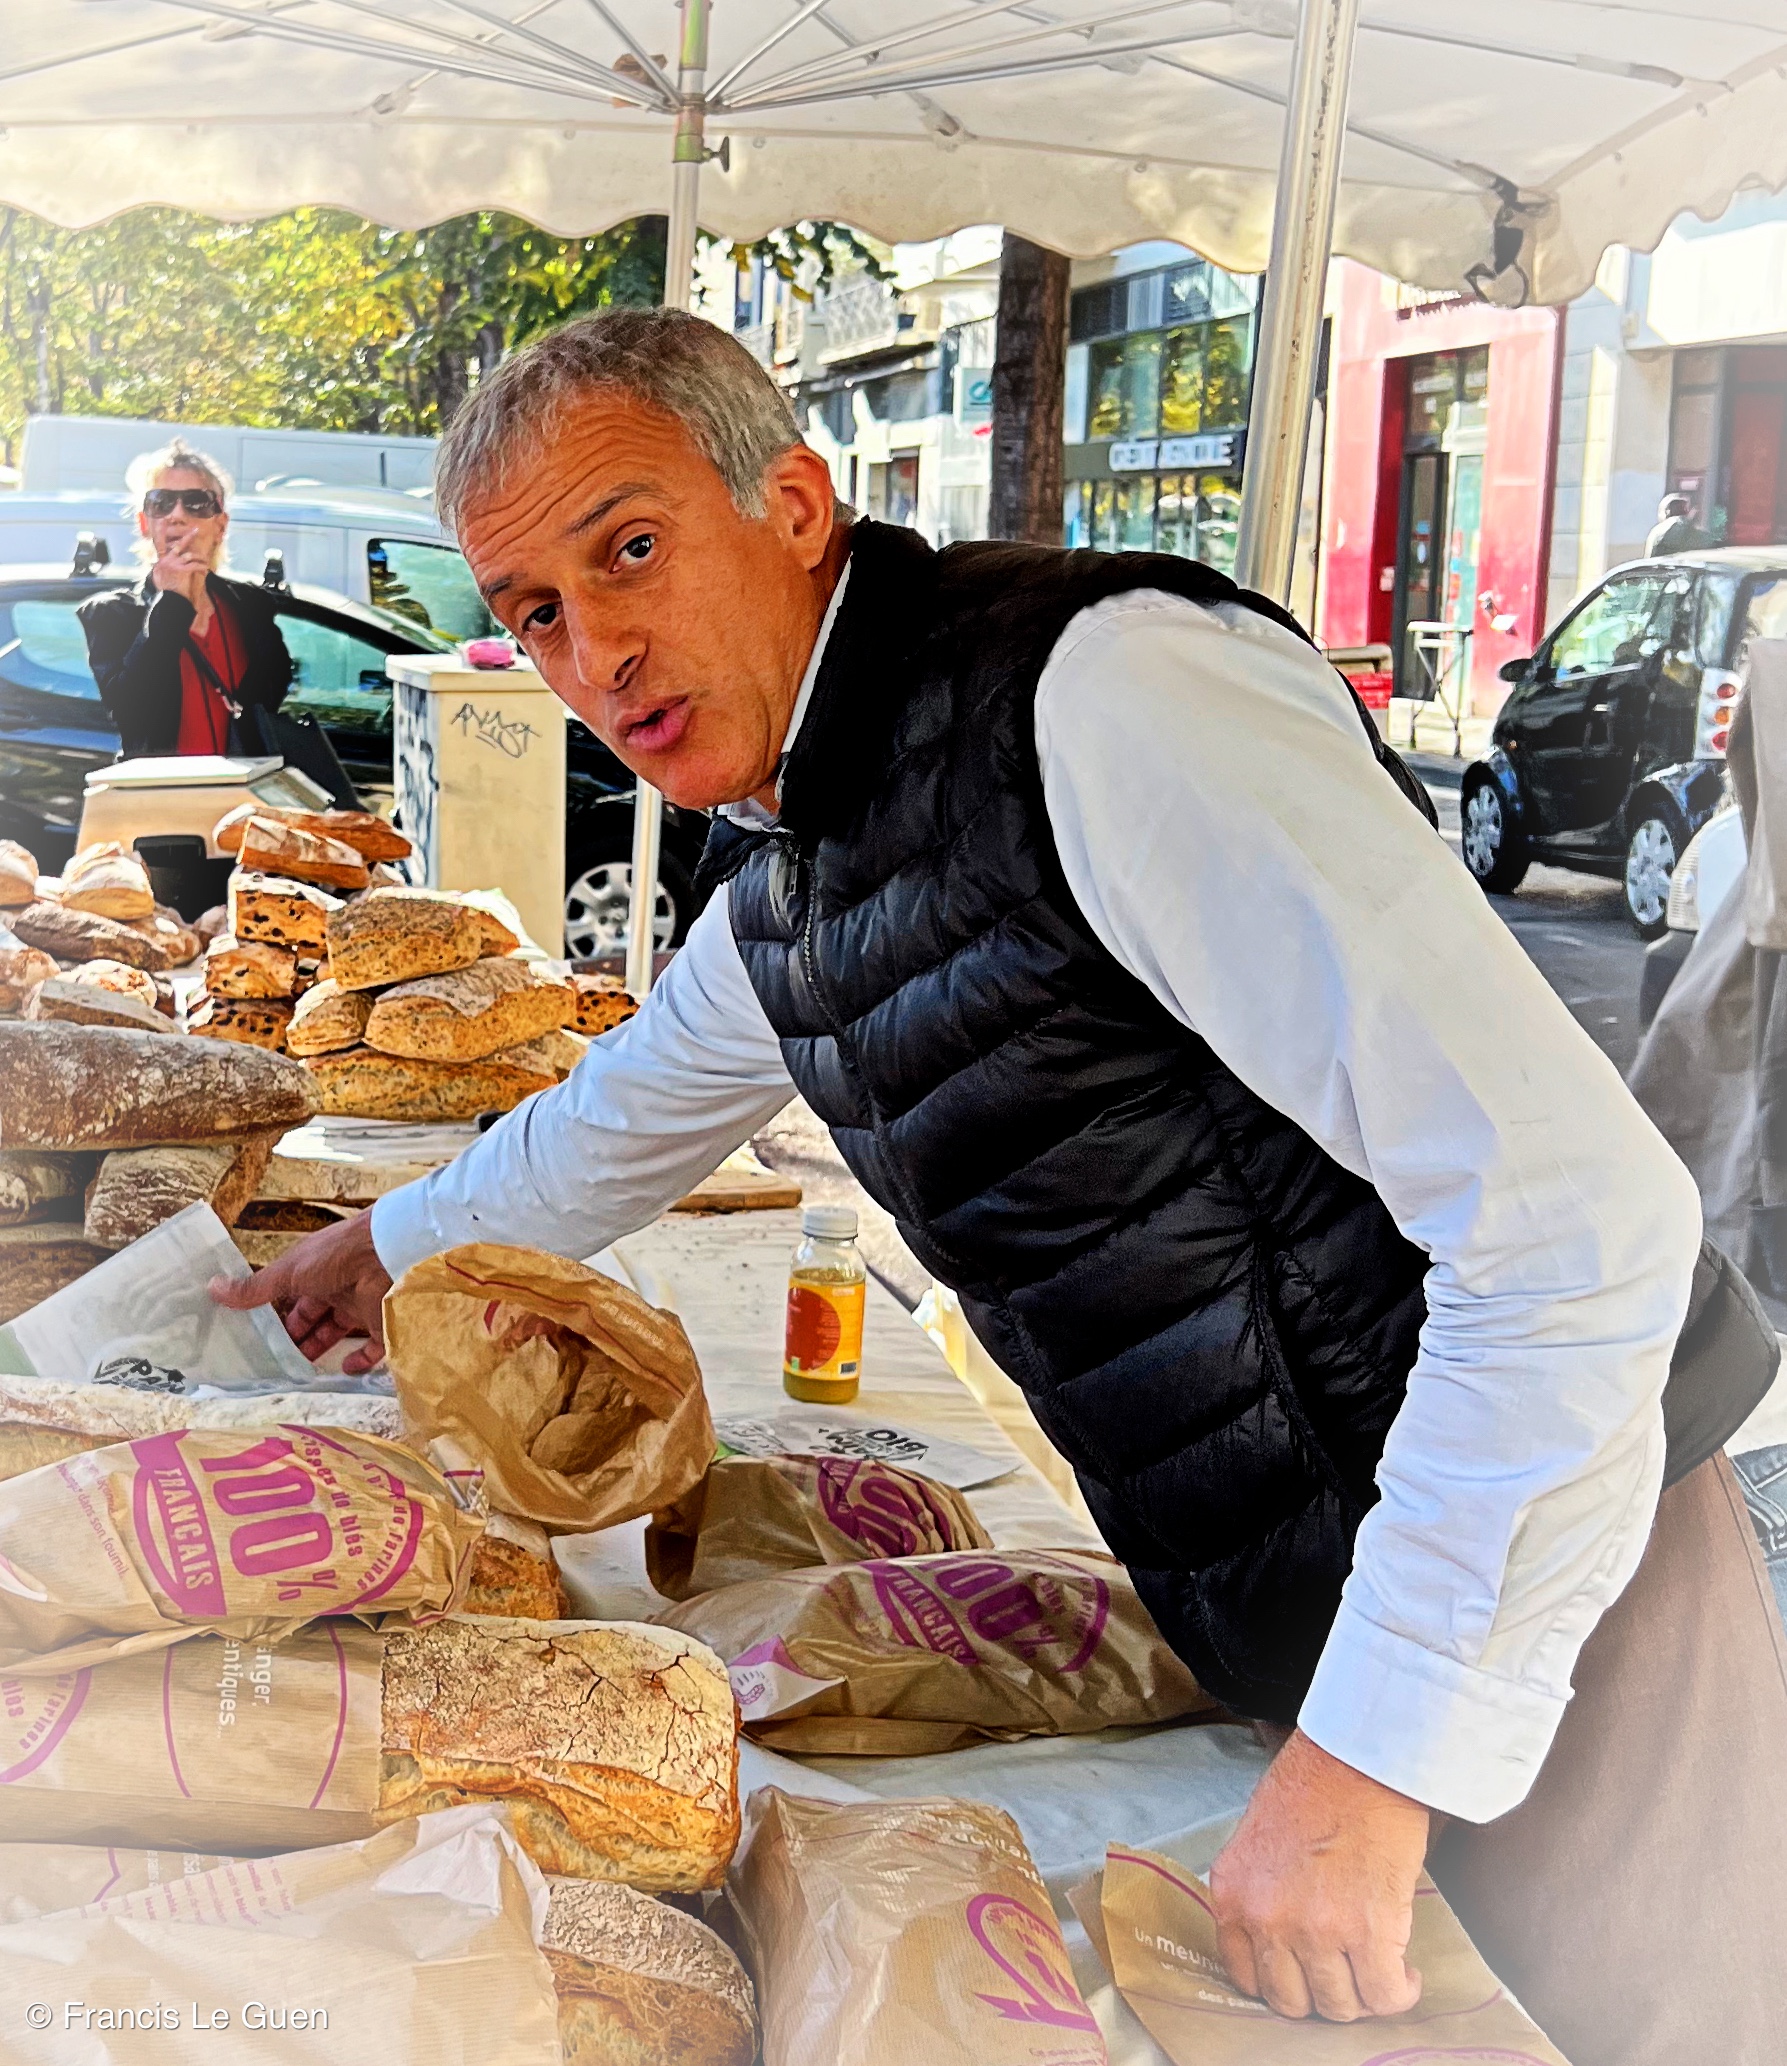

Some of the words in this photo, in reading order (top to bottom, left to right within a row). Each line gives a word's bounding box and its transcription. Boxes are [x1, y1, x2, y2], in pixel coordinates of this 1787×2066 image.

[90, 1517, 107, 1539] son
[340, 1514, 365, 1557] blés
[357, 1532, 403, 1591] farines
